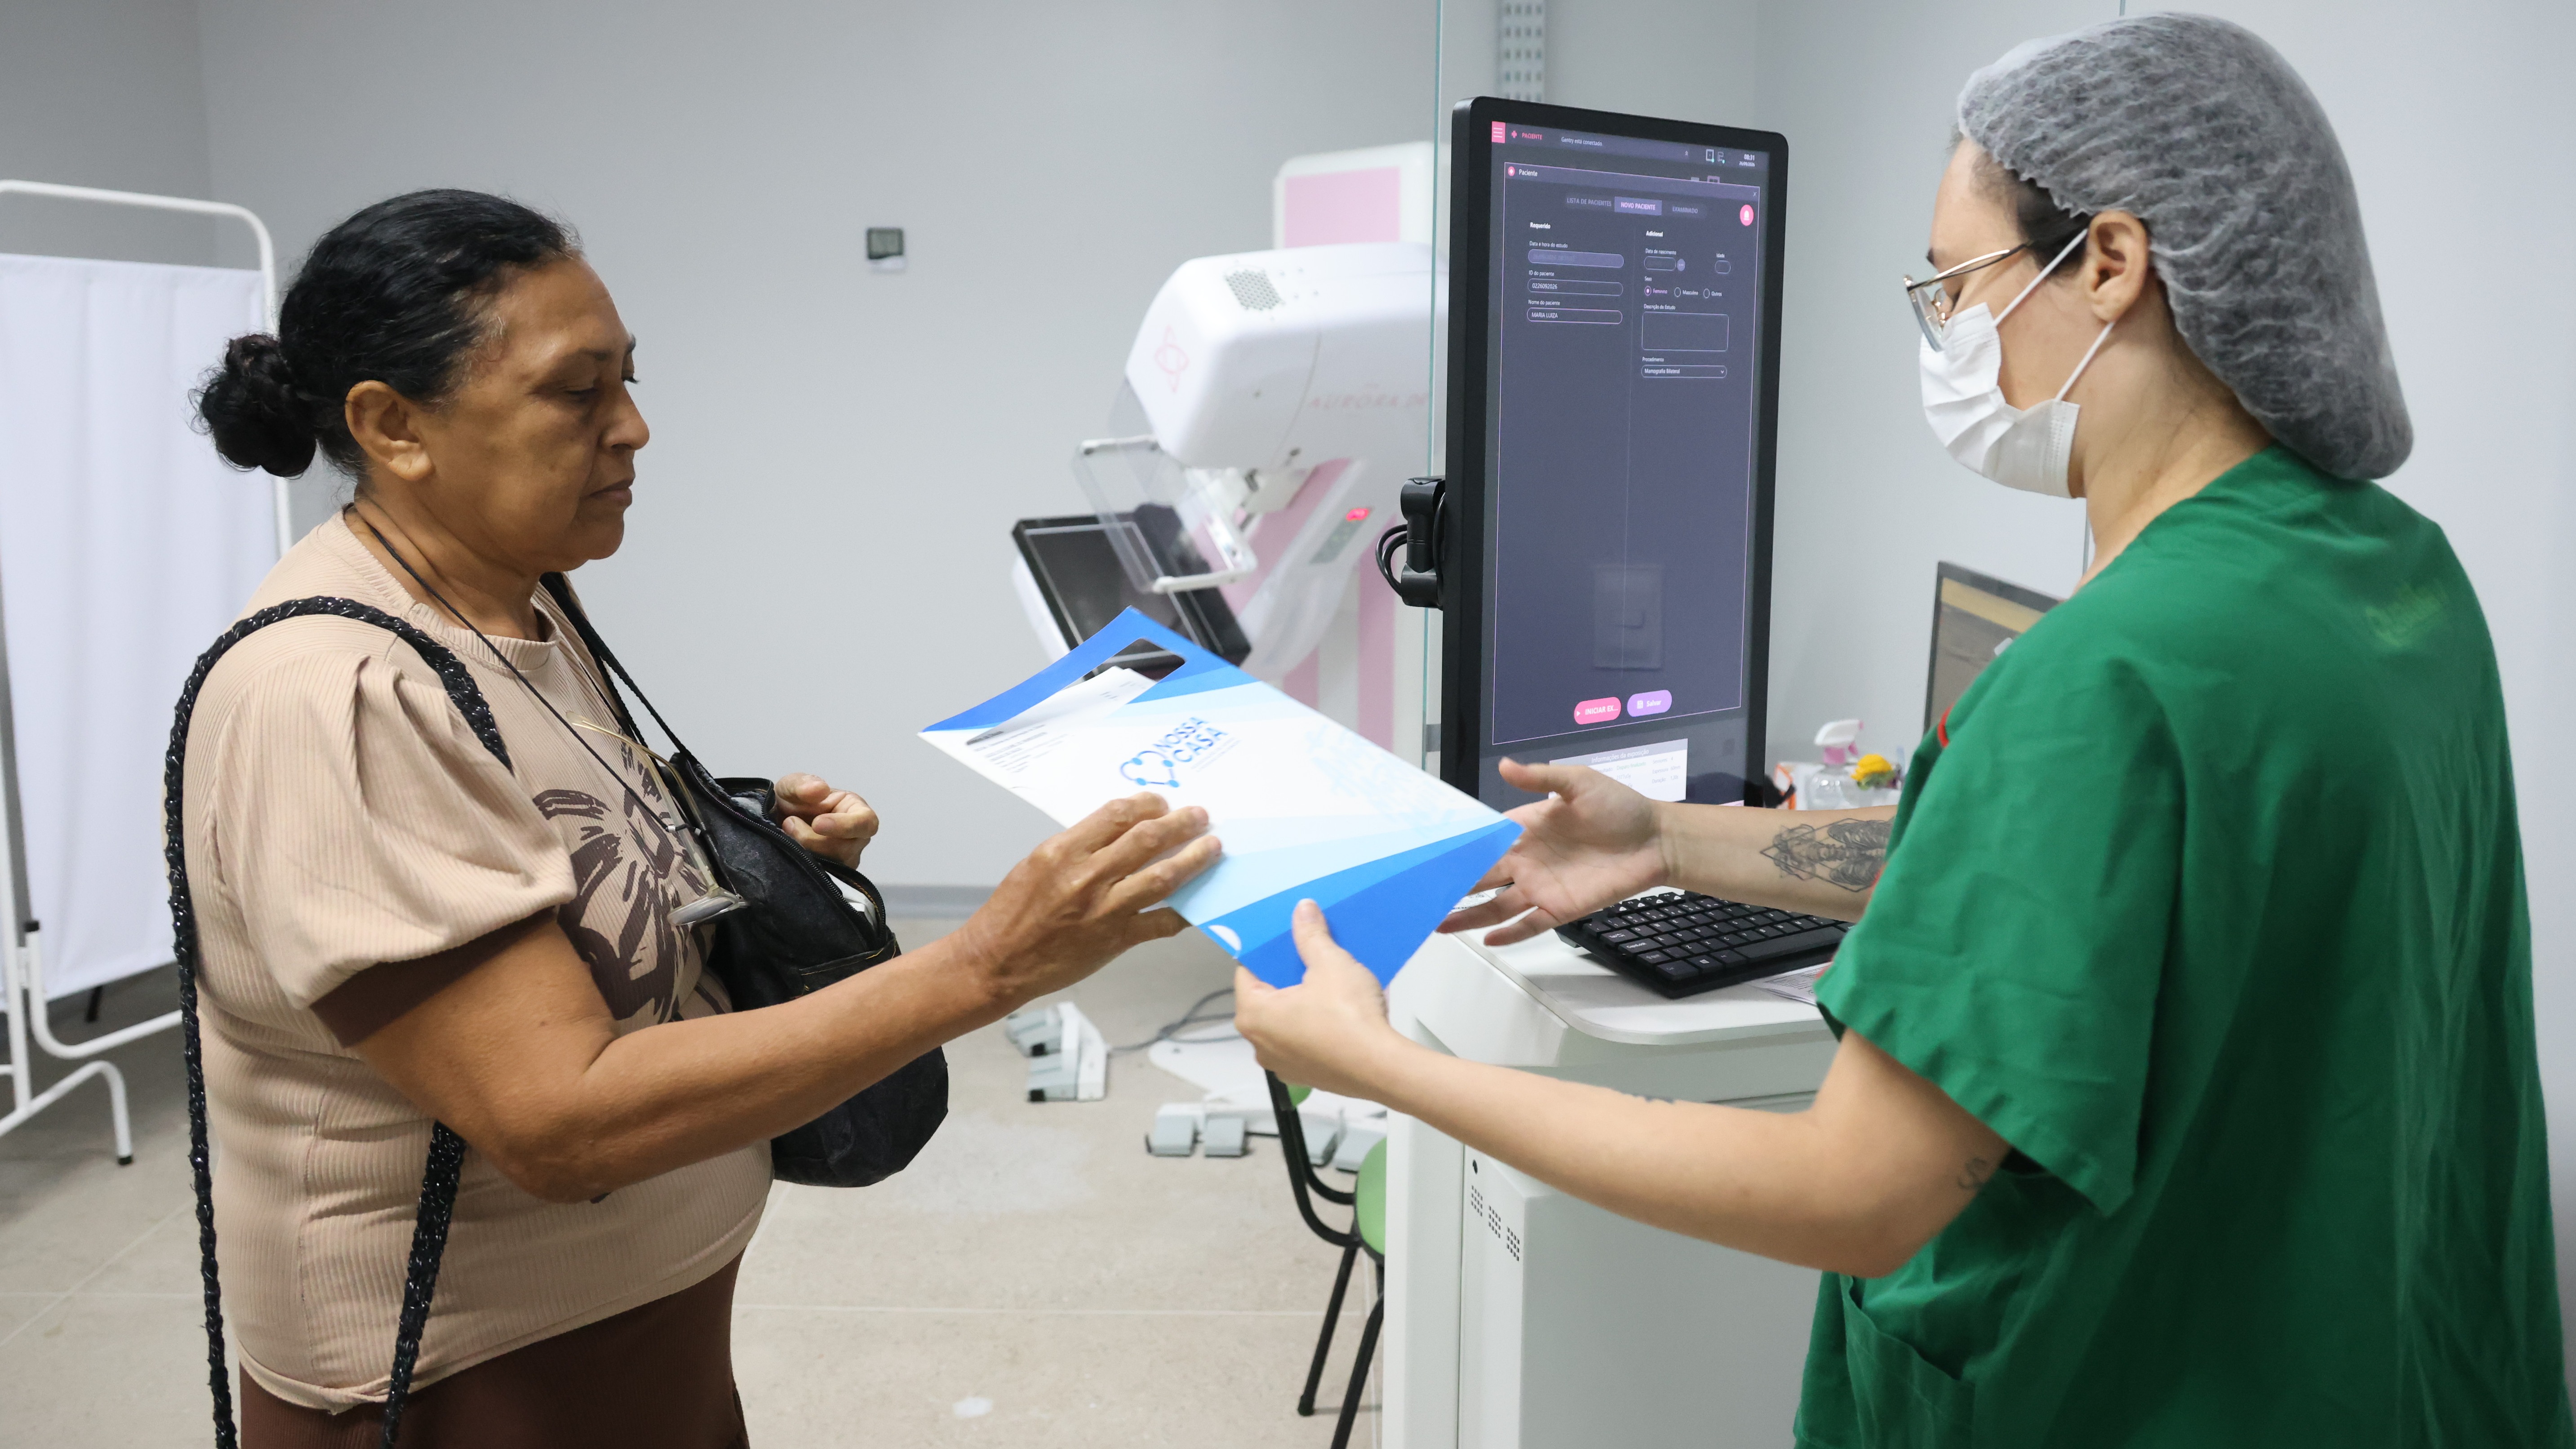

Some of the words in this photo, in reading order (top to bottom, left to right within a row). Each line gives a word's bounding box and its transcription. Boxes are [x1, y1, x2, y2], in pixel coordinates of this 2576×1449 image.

[1519, 169, 1538, 177] Paciente
[1646, 699, 1661, 707] Salvar
[1585, 706, 1606, 715] INICIAR
[1153, 717, 1209, 752] NOSSA
[1173, 727, 1229, 763] CASA
[1591, 754, 1619, 763] Informações
[1627, 749, 1649, 759] exposição
